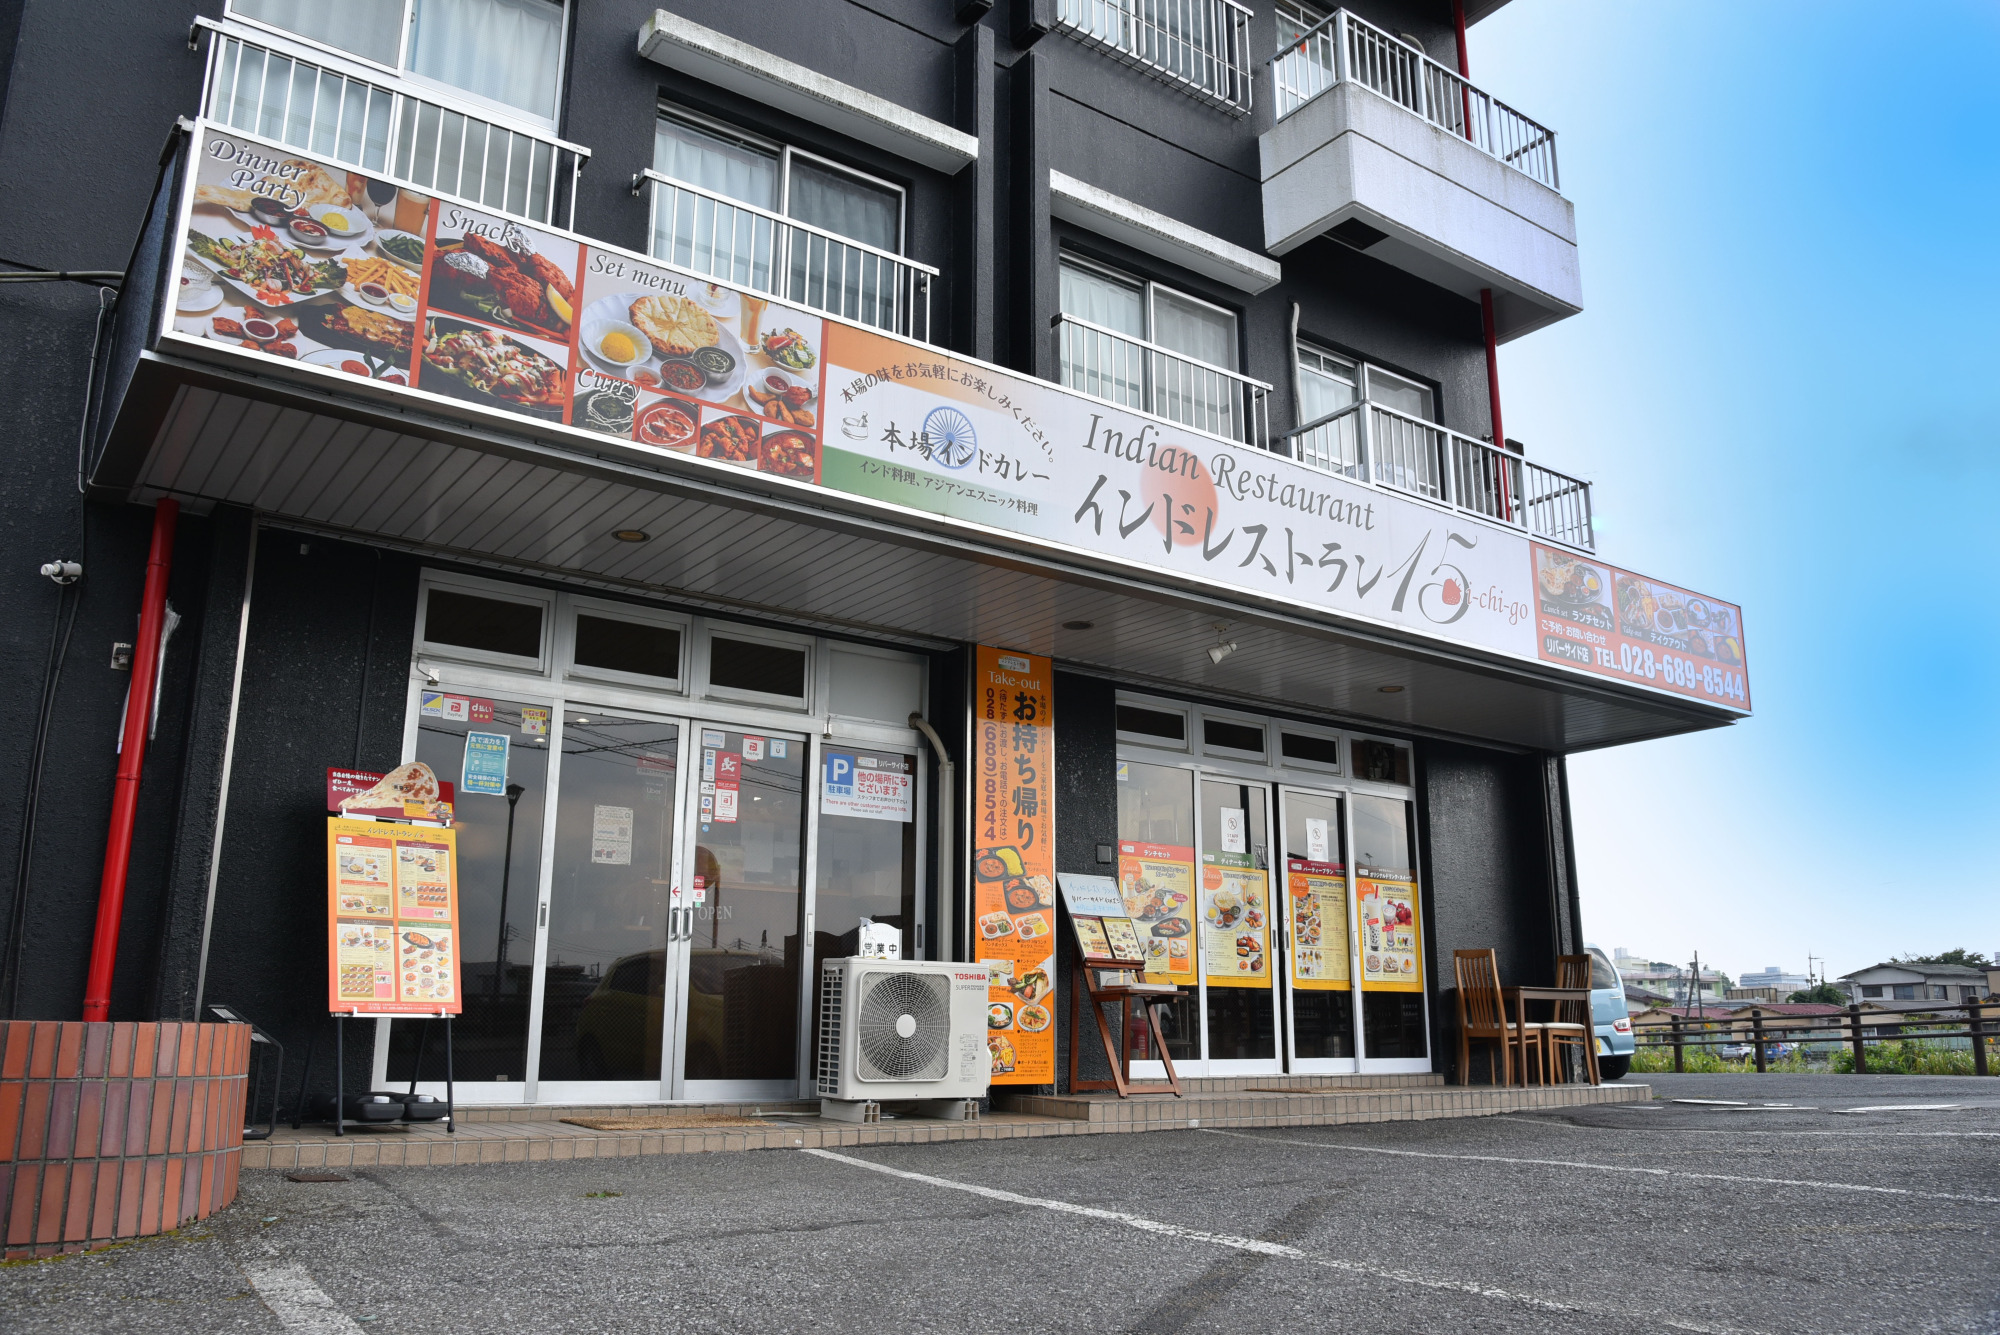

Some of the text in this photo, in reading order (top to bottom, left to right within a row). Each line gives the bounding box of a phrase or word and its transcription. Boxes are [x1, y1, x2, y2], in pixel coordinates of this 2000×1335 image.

[208, 138, 309, 182] Dinner
[230, 168, 308, 212] Party
[442, 209, 521, 251] Snack
[589, 254, 688, 297] Set menu
[577, 368, 642, 405] Curry
[840, 362, 1054, 463] 本場の味をお気軽にお楽しみください。
[880, 421, 1051, 482] 本場インドカレー
[1082, 413, 1375, 531] Indian Restaurant
[859, 460, 1038, 517] インド料理、アジアンエスニック料理
[1074, 474, 1478, 624] インドレストラン 15
[1466, 581, 1528, 626] i-chi-go
[1541, 619, 1607, 646] ご予約・お問い合わせ
[1572, 610, 1613, 630] ランチセット
[1546, 638, 1589, 663] リバーサイド店
[1650, 632, 1687, 651] テイクアウト
[987, 670, 1041, 690] Take-out
[471, 702, 492, 713] d払い
[833, 758, 849, 781] P
[878, 760, 909, 771] リバーサイド店
[983, 687, 998, 841] 028(689)8544
[1012, 691, 1038, 851] お持ち帰り
[827, 784, 851, 795] 駐車場
[857, 771, 908, 787] 他の場所にも
[857, 782, 901, 797] ございます。
[1144, 849, 1171, 858] ランチセット
[1220, 858, 1250, 867] ディナーセット
[1302, 866, 1334, 875] パーティープラン
[698, 905, 732, 920] OPEN
